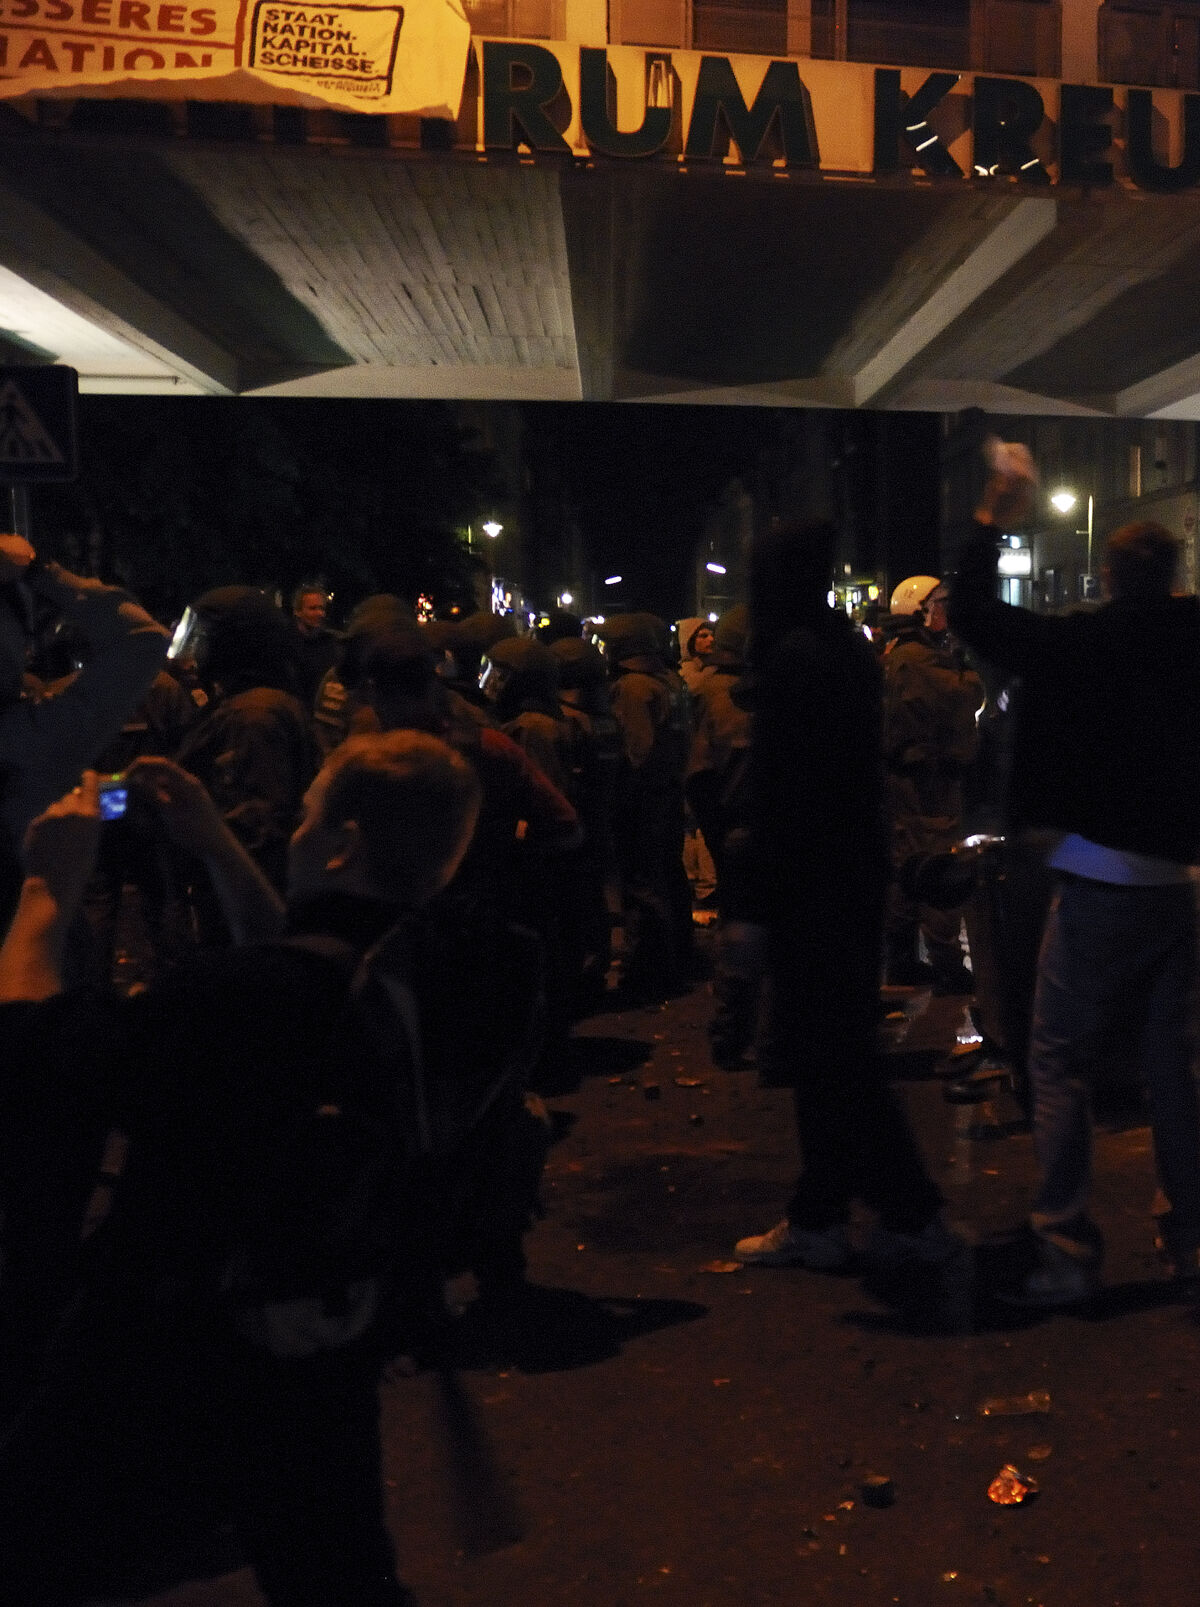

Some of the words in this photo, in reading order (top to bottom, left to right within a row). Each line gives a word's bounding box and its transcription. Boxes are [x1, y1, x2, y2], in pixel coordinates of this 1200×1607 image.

[0, 0, 217, 35] SSERES
[265, 9, 343, 28] STAAT.
[262, 20, 358, 41] NATION.
[0, 36, 213, 72] ATION
[261, 36, 367, 56] KAPITAL.
